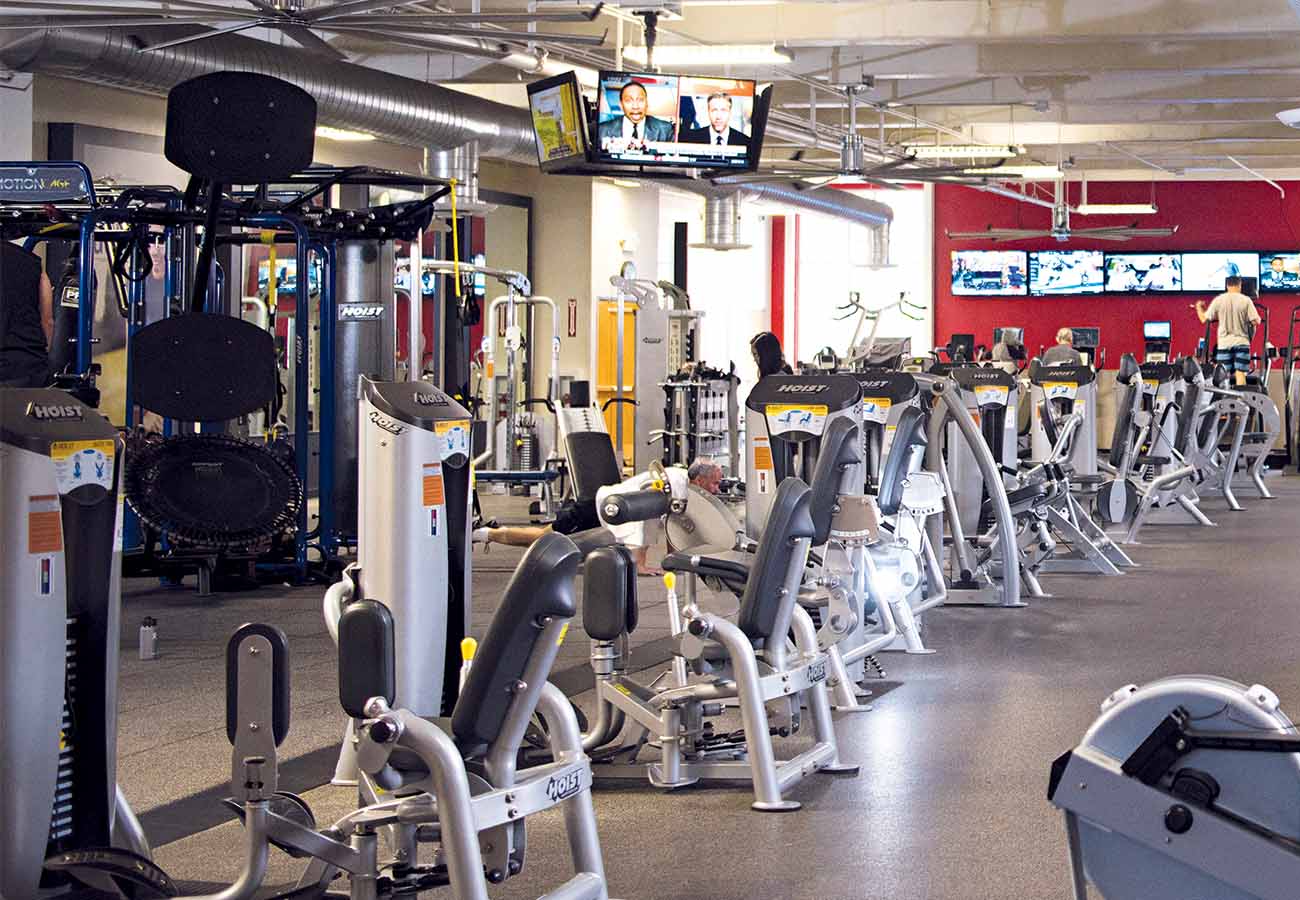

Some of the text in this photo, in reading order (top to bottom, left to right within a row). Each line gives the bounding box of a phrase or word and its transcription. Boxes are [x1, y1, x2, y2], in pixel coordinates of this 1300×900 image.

[341, 306, 384, 317] HOIST
[776, 384, 829, 393] HOIST
[859, 380, 889, 388] OIST
[34, 405, 83, 418] HOIST
[546, 767, 584, 802] HOIST
